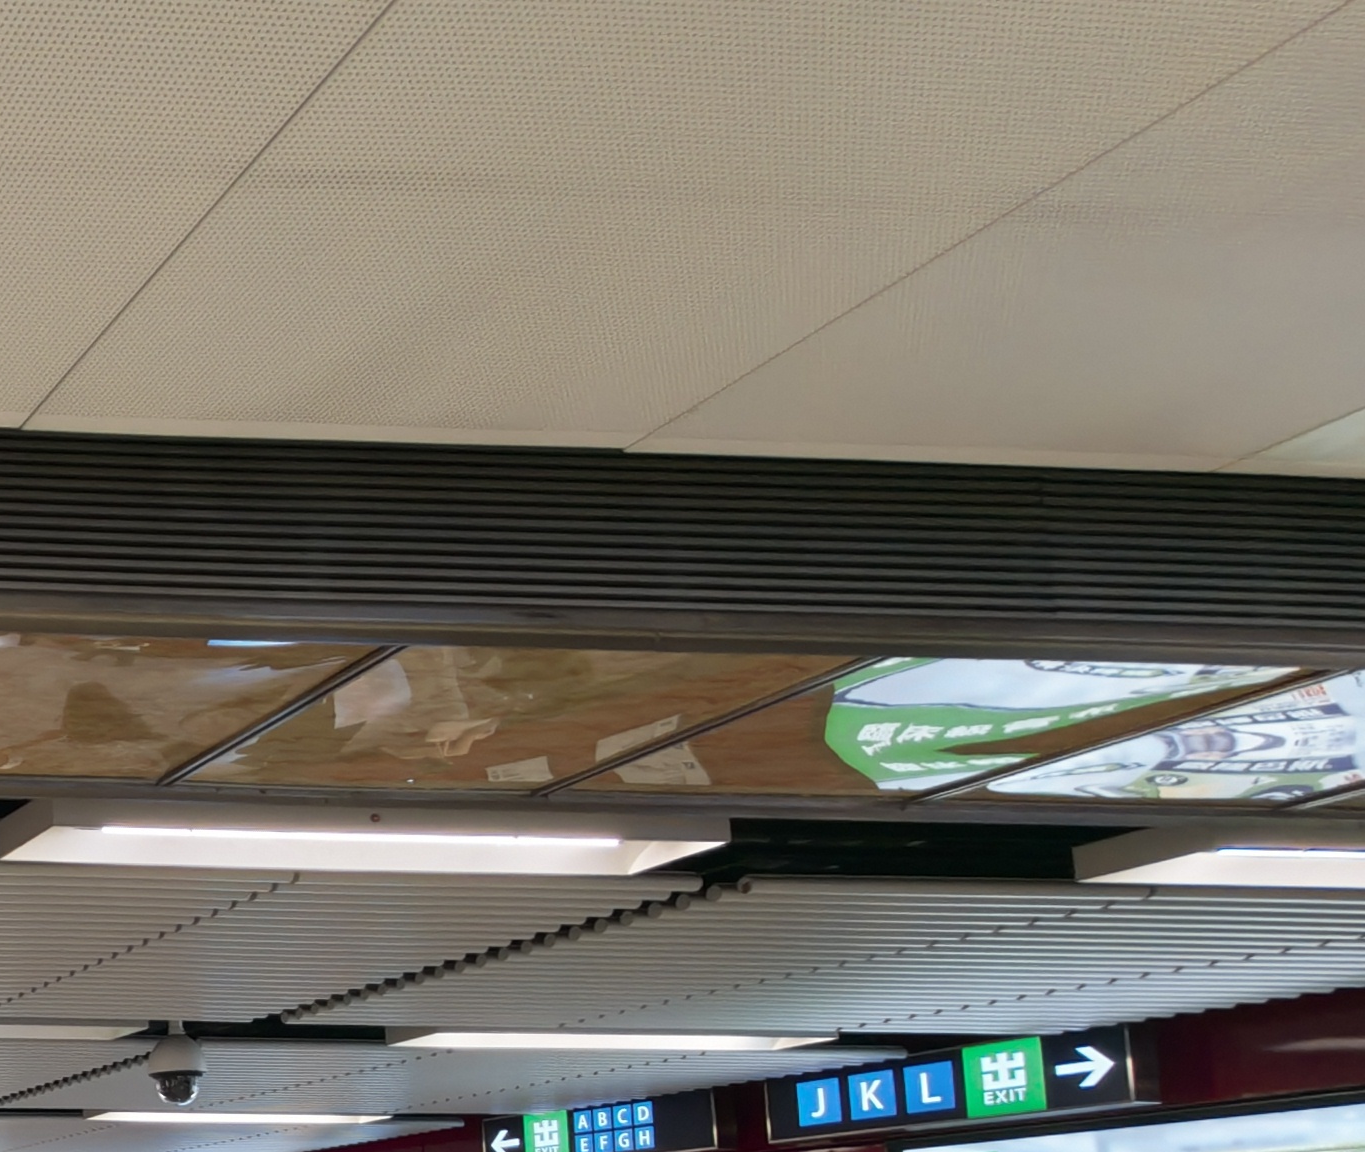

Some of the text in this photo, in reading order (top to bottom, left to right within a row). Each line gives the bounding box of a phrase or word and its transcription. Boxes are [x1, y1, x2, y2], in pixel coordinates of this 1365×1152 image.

[980, 1051, 1027, 1091] 出
[811, 1072, 942, 1118] J K L
[983, 1088, 1026, 1106] EXIT
[577, 1105, 650, 1130] A B C D
[533, 1119, 559, 1147] 出
[579, 1130, 651, 1152] E F G H
